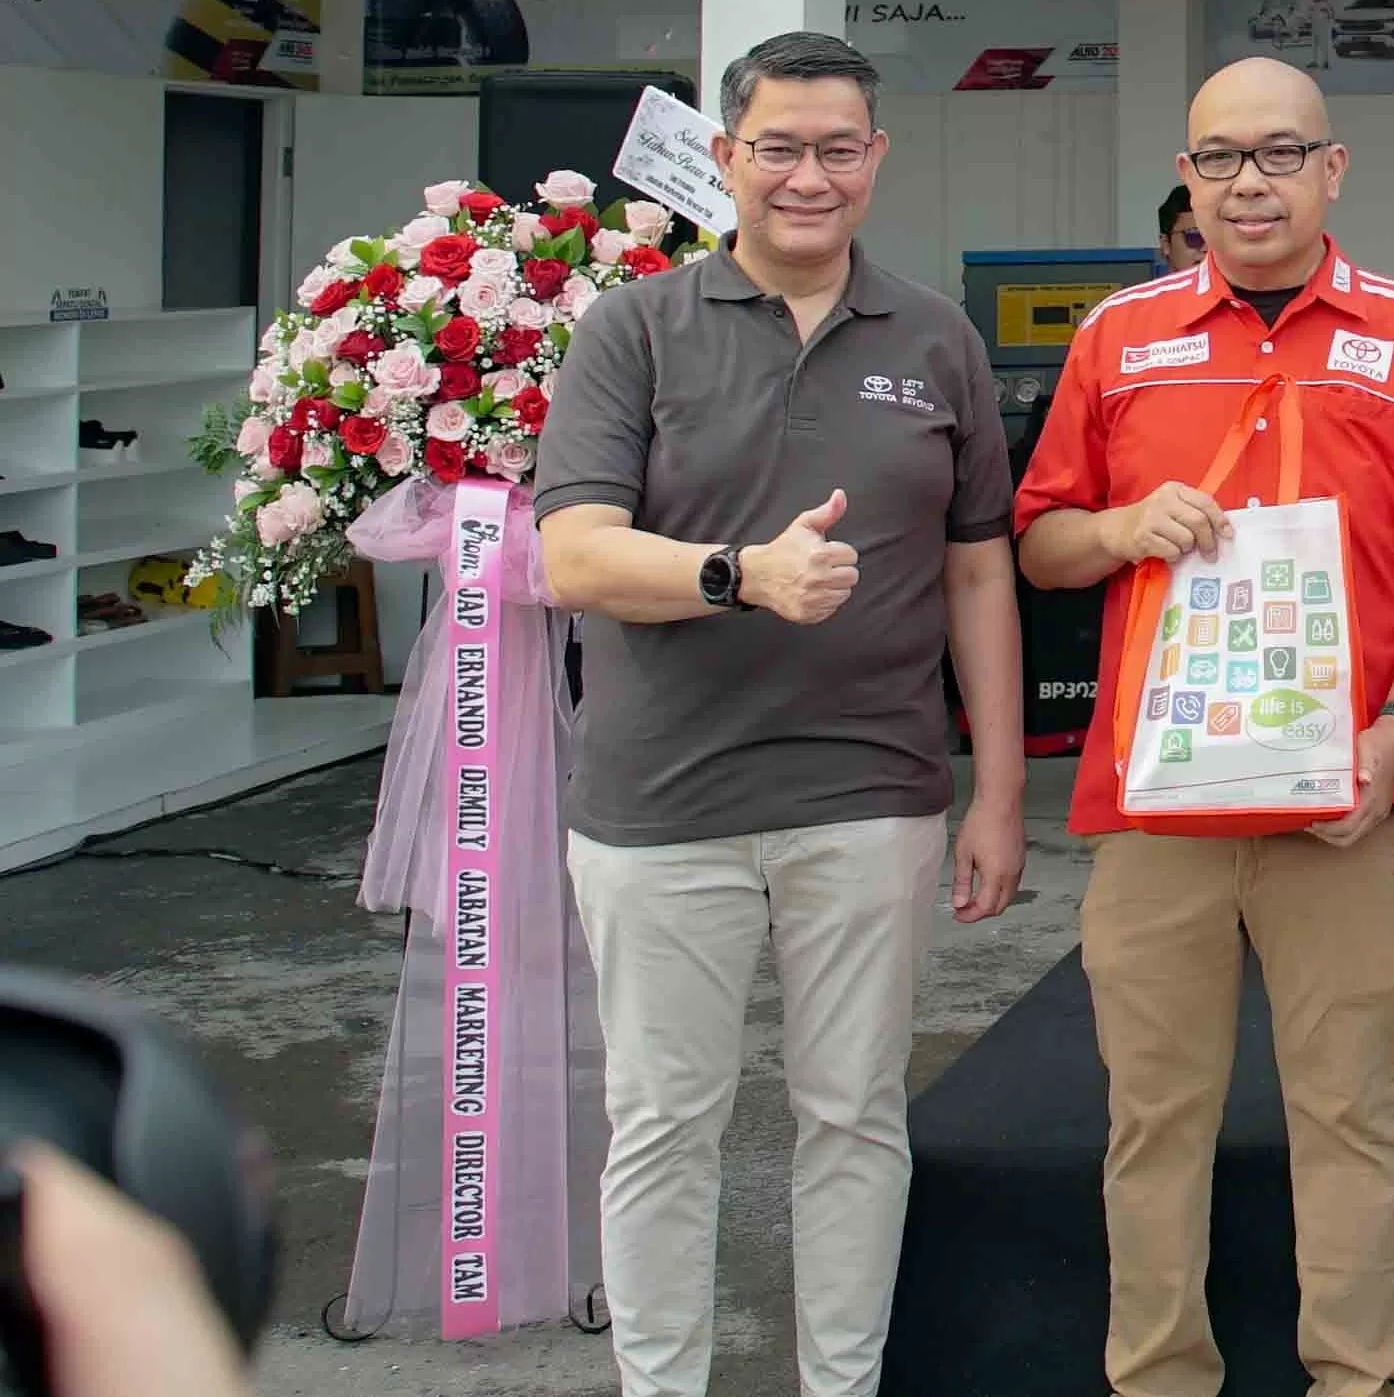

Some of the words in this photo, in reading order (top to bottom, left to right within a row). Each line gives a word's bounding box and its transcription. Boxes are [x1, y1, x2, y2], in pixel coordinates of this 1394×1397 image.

[1333, 359, 1384, 380] TOYOTA
[858, 391, 898, 403] TOYOTA
[457, 588, 485, 626] JAP
[456, 647, 485, 748] ERNANDO
[1258, 695, 1287, 716] life
[1290, 697, 1305, 715] is
[1283, 719, 1328, 743] easy
[457, 768, 487, 848] DEMILY
[457, 871, 487, 967] JABATAN
[453, 986, 487, 1114] MARKETING
[453, 1134, 484, 1240] DIRECTOR
[453, 1254, 484, 1300] TAM
